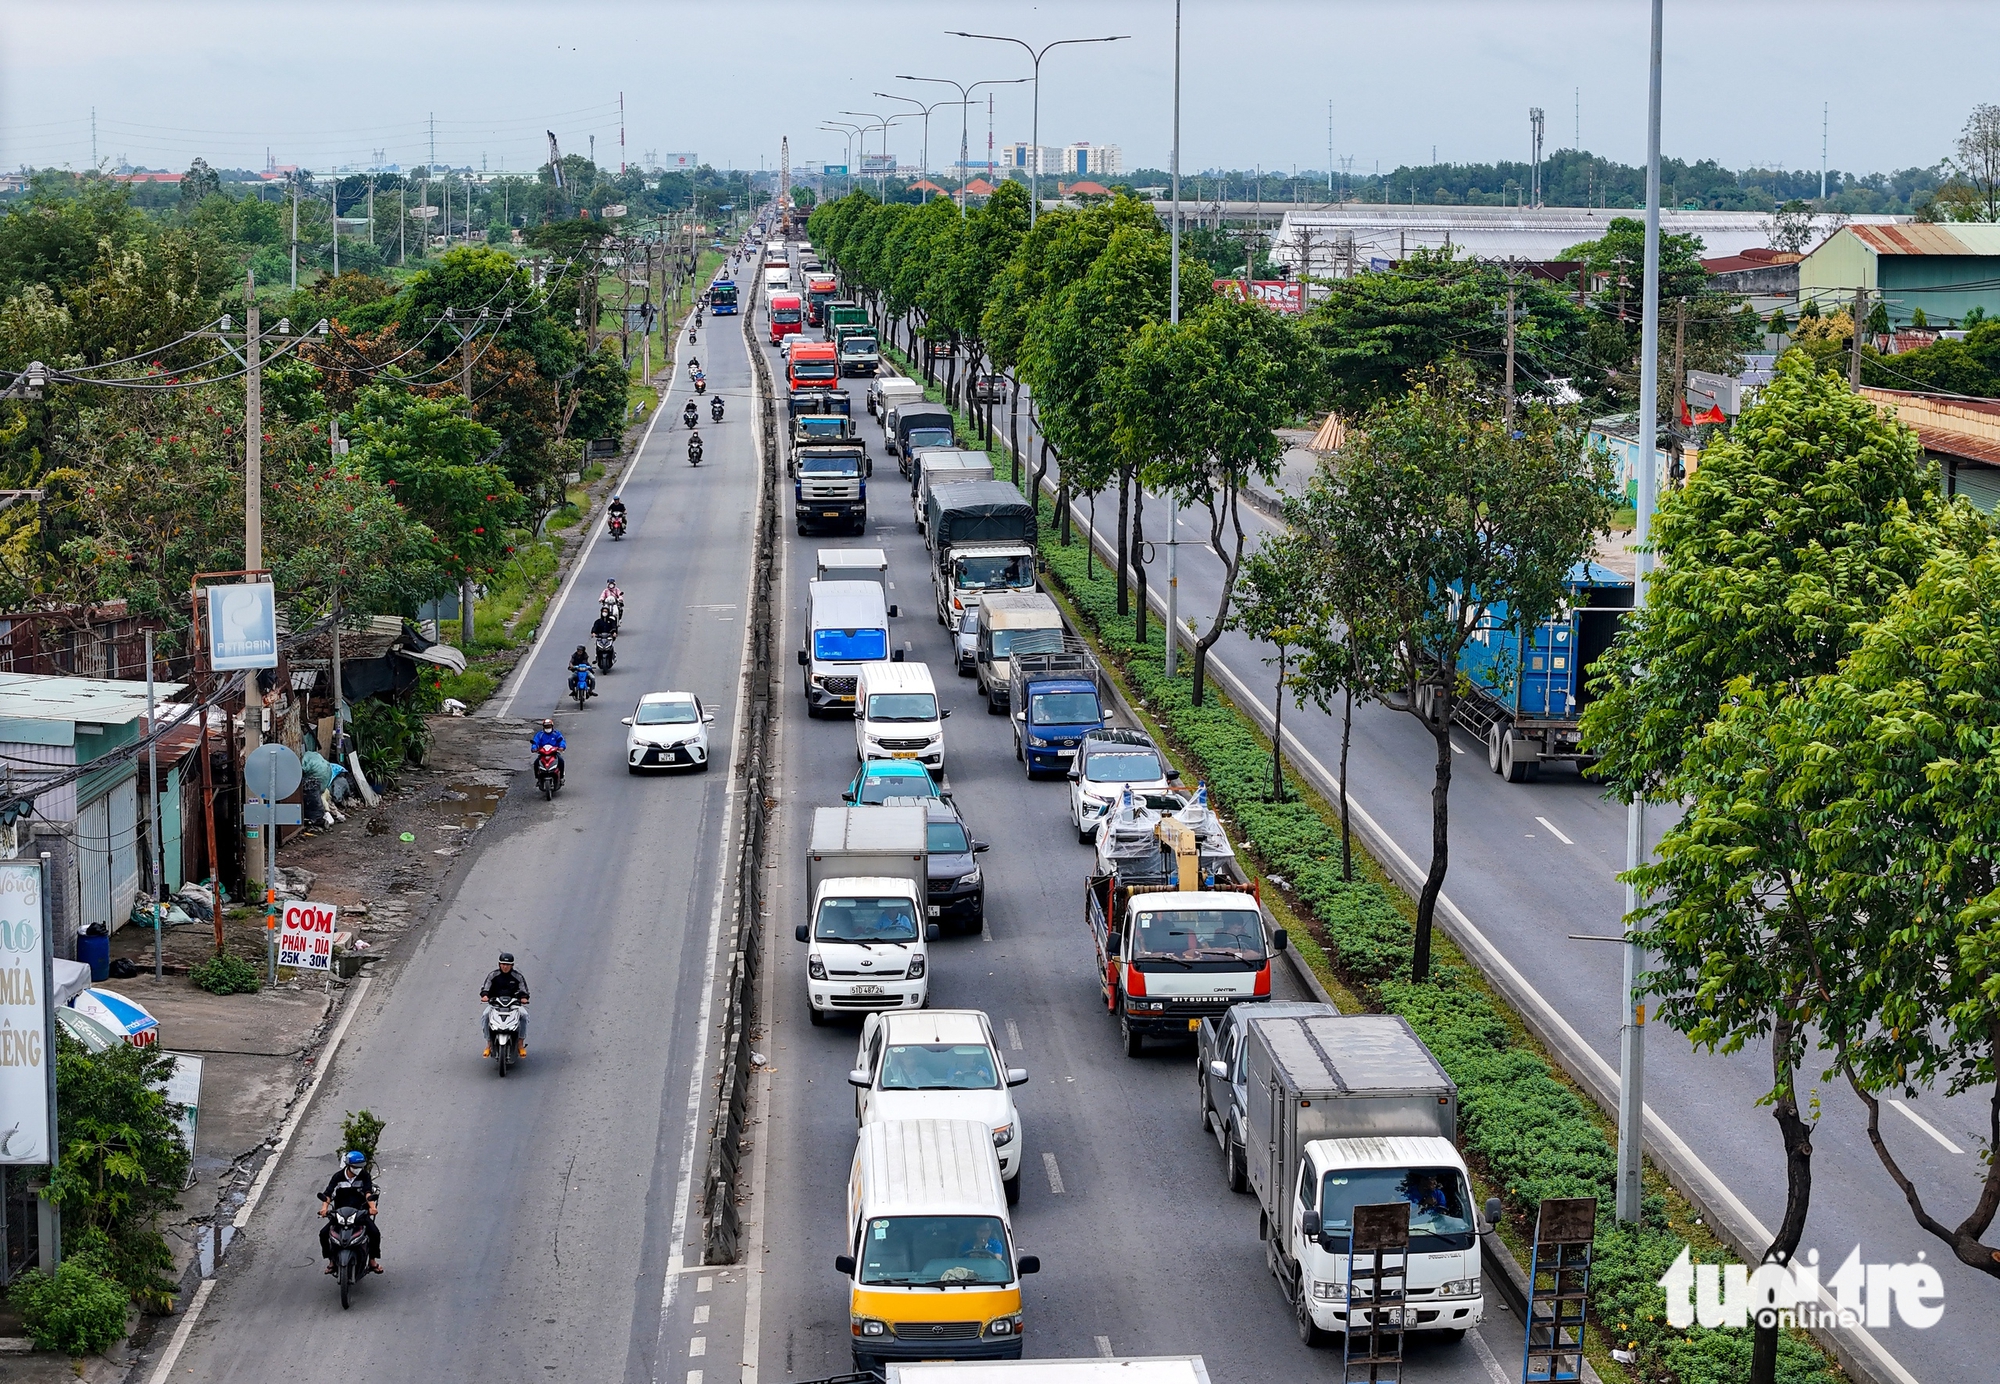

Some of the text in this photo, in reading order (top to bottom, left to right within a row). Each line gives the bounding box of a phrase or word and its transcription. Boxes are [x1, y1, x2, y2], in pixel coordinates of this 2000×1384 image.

[286, 906, 334, 934] CƠM
[280, 951, 301, 965] 25K
[309, 954, 328, 968] 30K
[0, 956, 36, 1006] MÍA
[0, 1017, 42, 1067] ÊNG
